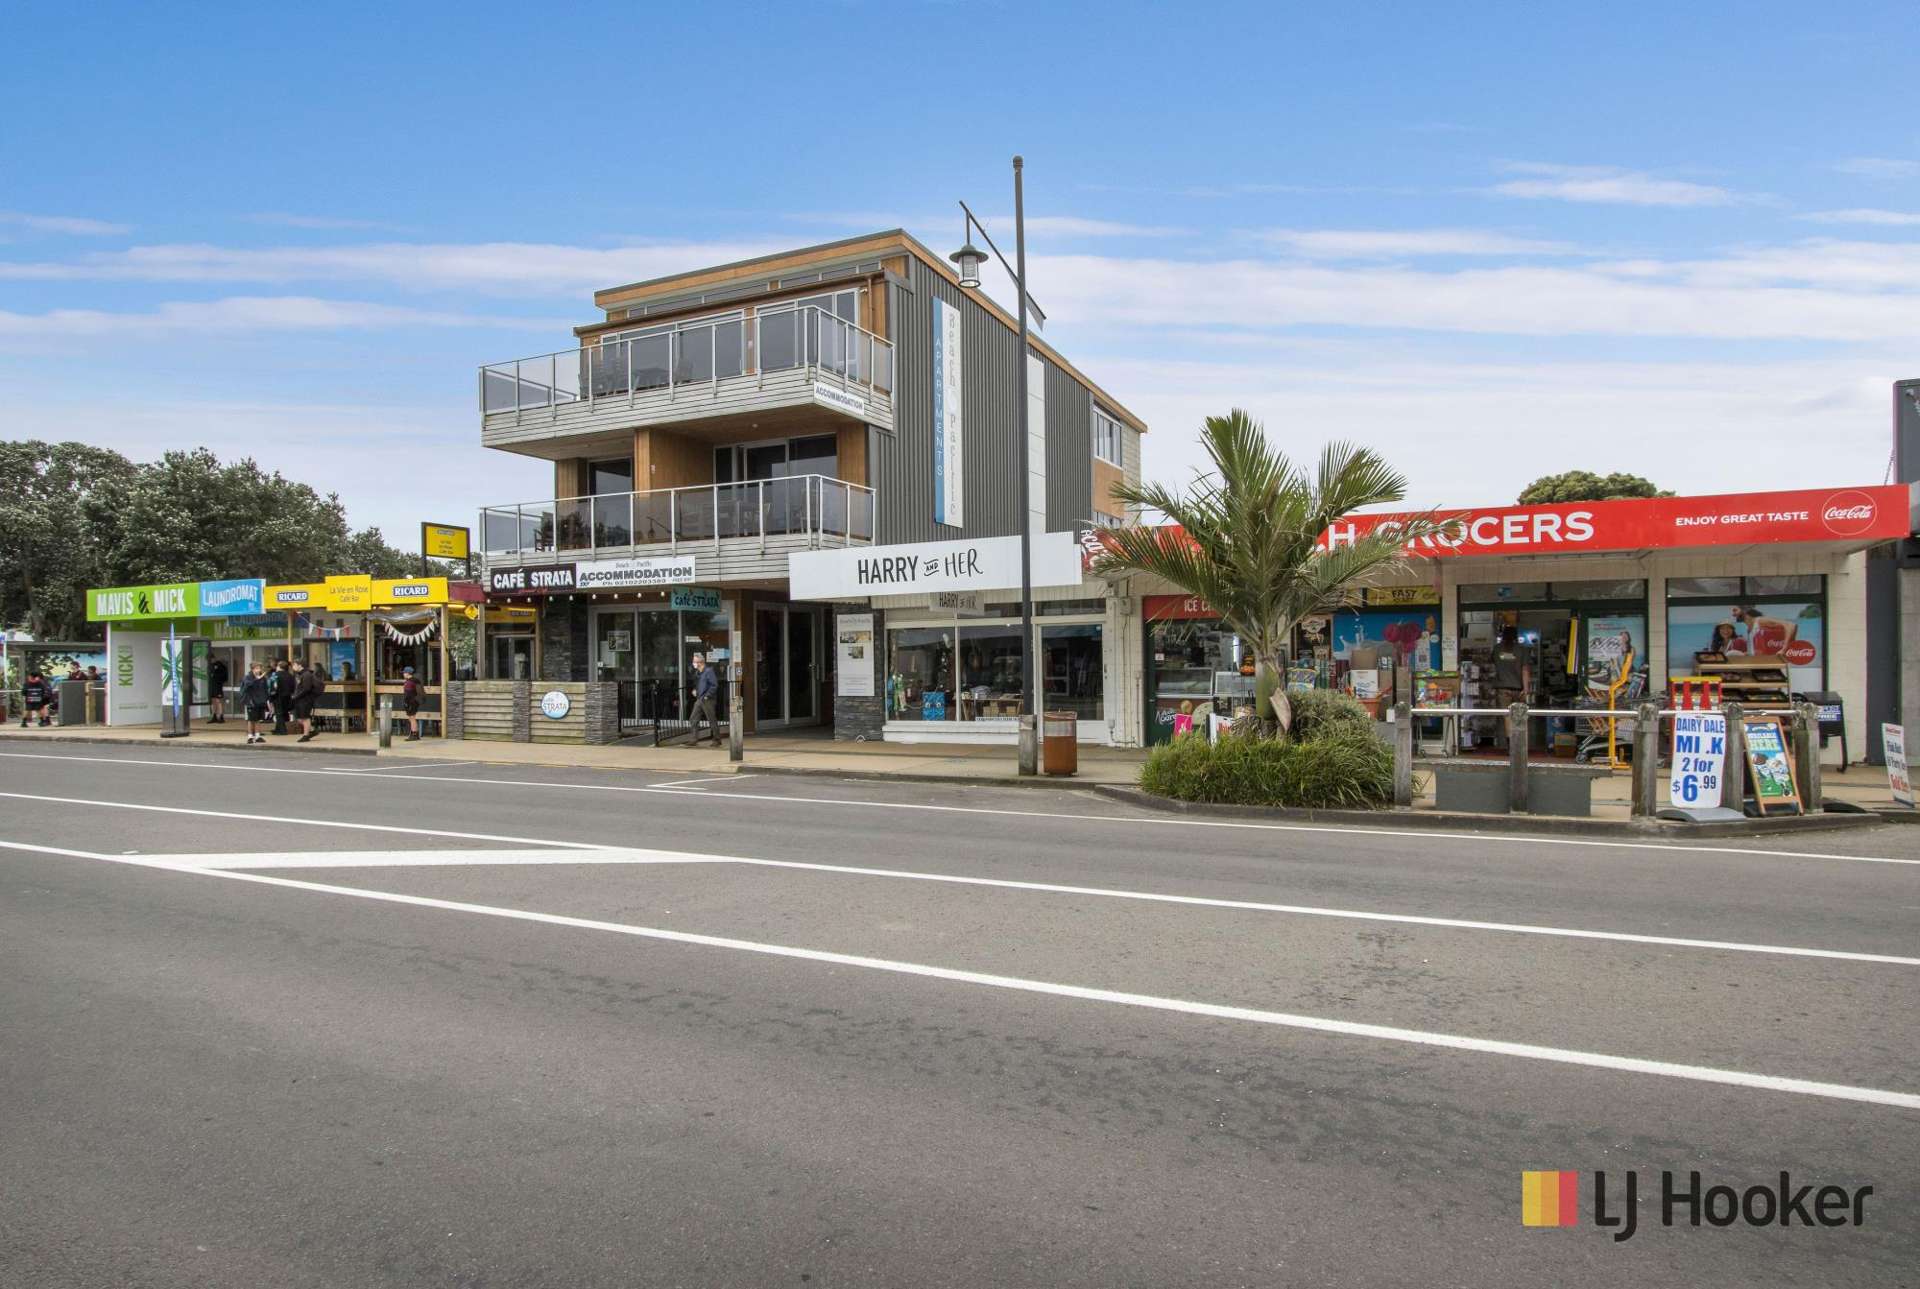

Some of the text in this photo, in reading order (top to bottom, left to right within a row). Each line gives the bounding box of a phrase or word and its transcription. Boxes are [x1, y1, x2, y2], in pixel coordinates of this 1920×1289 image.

[816, 385, 863, 410] ACCOMMODATION
[1676, 511, 1808, 526] ENJOY GREAT TASTE
[1824, 505, 1873, 520] Coca-Cola
[858, 548, 983, 584] HARRY AND HER
[494, 569, 573, 588] CAFÉ STRATA
[579, 567, 692, 582] ACCOMMODATION
[202, 585, 259, 606] LAUNDROMAT
[277, 592, 308, 601] RICARD
[394, 586, 428, 596] RICARD
[96, 588, 187, 616] MAVIS & MICK
[1184, 600, 1198, 612] ICE
[1676, 717, 1725, 734] DAIRY DALE
[1676, 735, 1723, 755] MIK
[1682, 757, 1714, 773] 2 for
